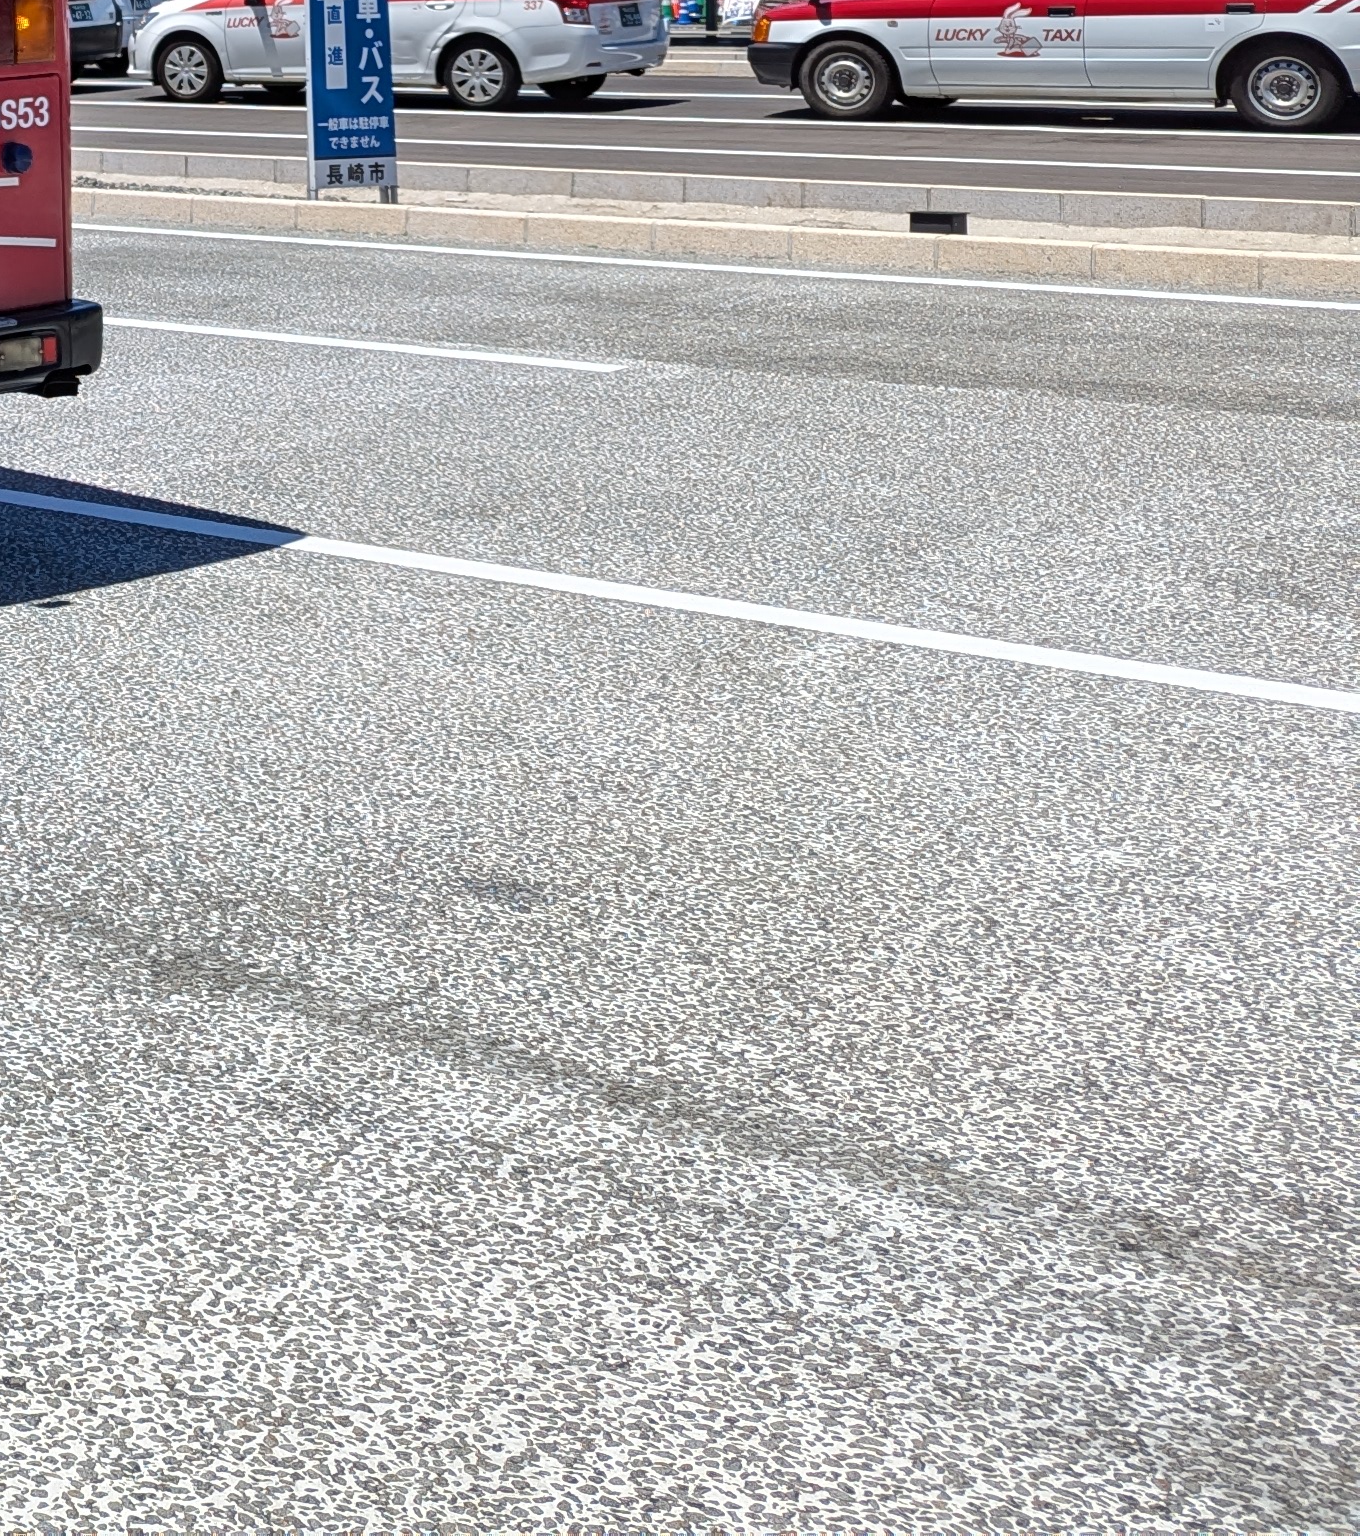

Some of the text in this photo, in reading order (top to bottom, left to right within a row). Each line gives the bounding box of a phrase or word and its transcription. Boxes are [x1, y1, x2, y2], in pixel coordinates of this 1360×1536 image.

[524, 0, 543, 10] 337
[227, 16, 264, 28] LUCKY
[326, 5, 344, 66] 直進
[935, 29, 1083, 41] LUCKY TAXI
[317, 116, 390, 132] 一般車は駐停車
[329, 135, 381, 149] できません
[326, 162, 385, 185] 長崎市
